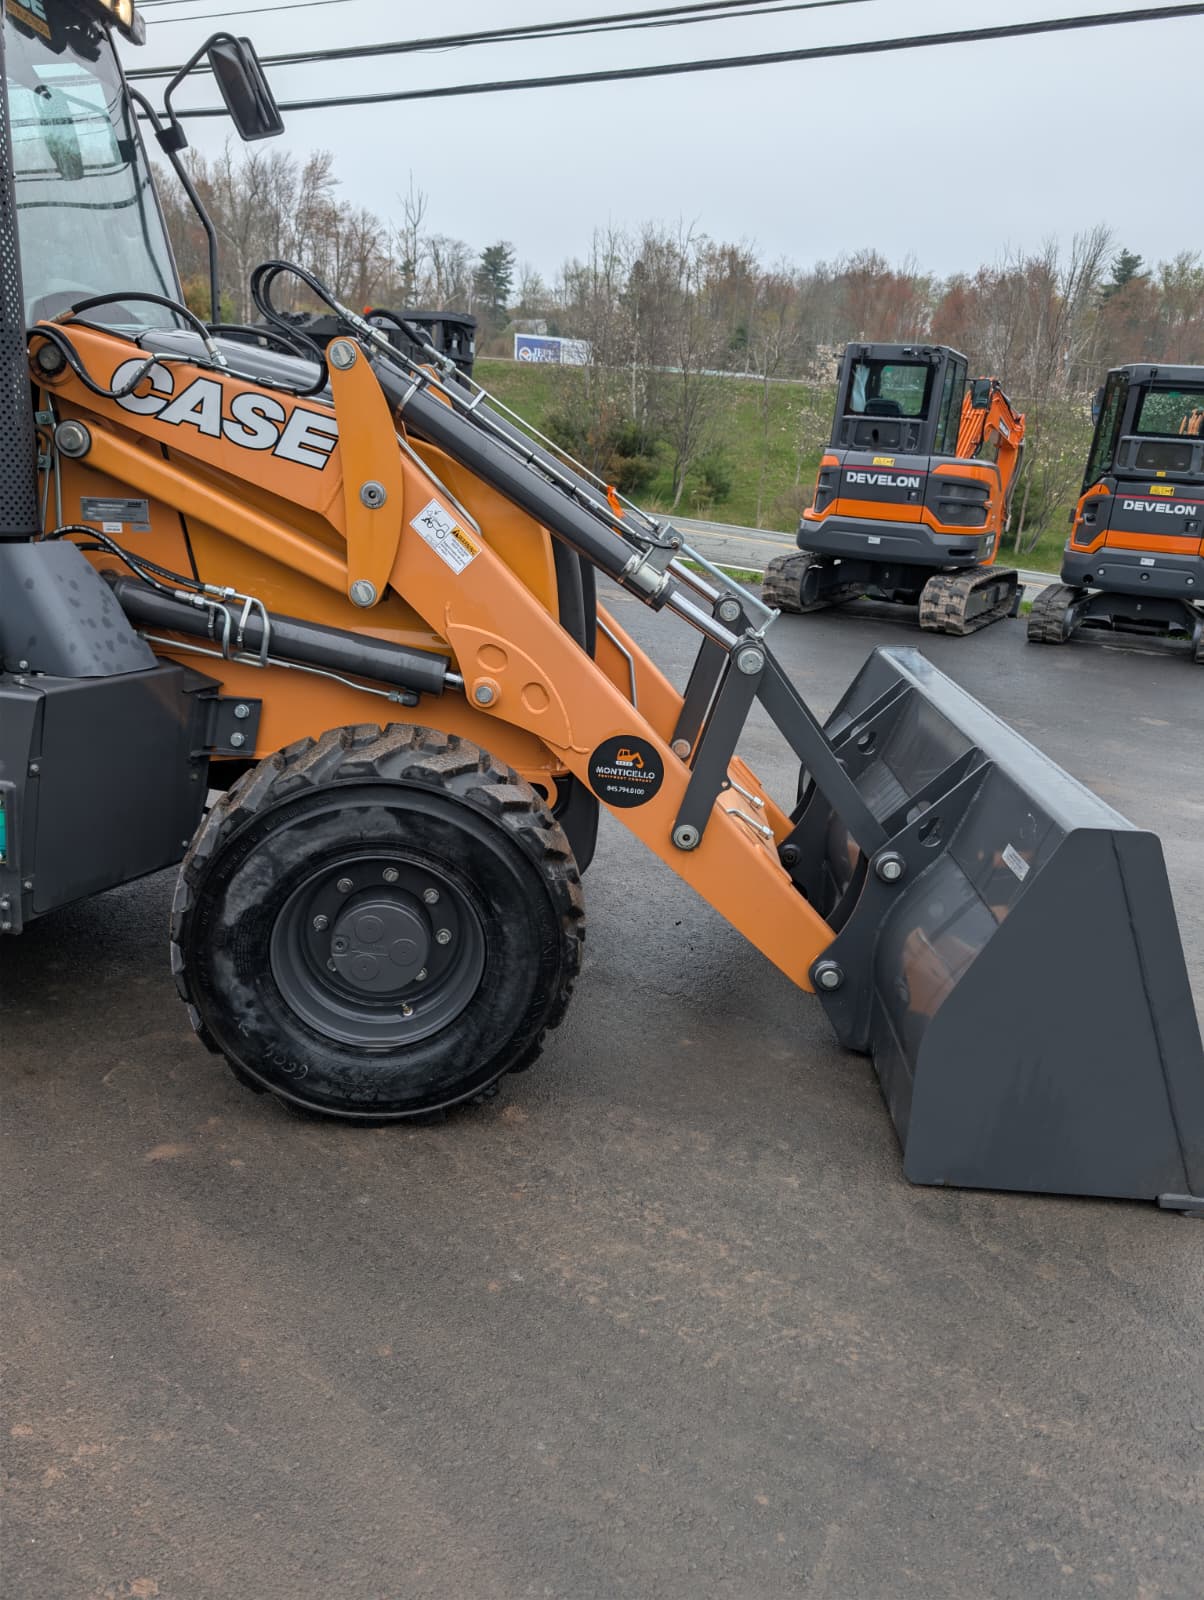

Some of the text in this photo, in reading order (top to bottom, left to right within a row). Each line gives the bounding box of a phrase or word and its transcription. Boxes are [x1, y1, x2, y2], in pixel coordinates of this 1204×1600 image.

[110, 358, 339, 471] CASE
[846, 471, 920, 488] DEVELON
[1123, 500, 1197, 515] DEVELON
[595, 766, 656, 780] MONTICELLO
